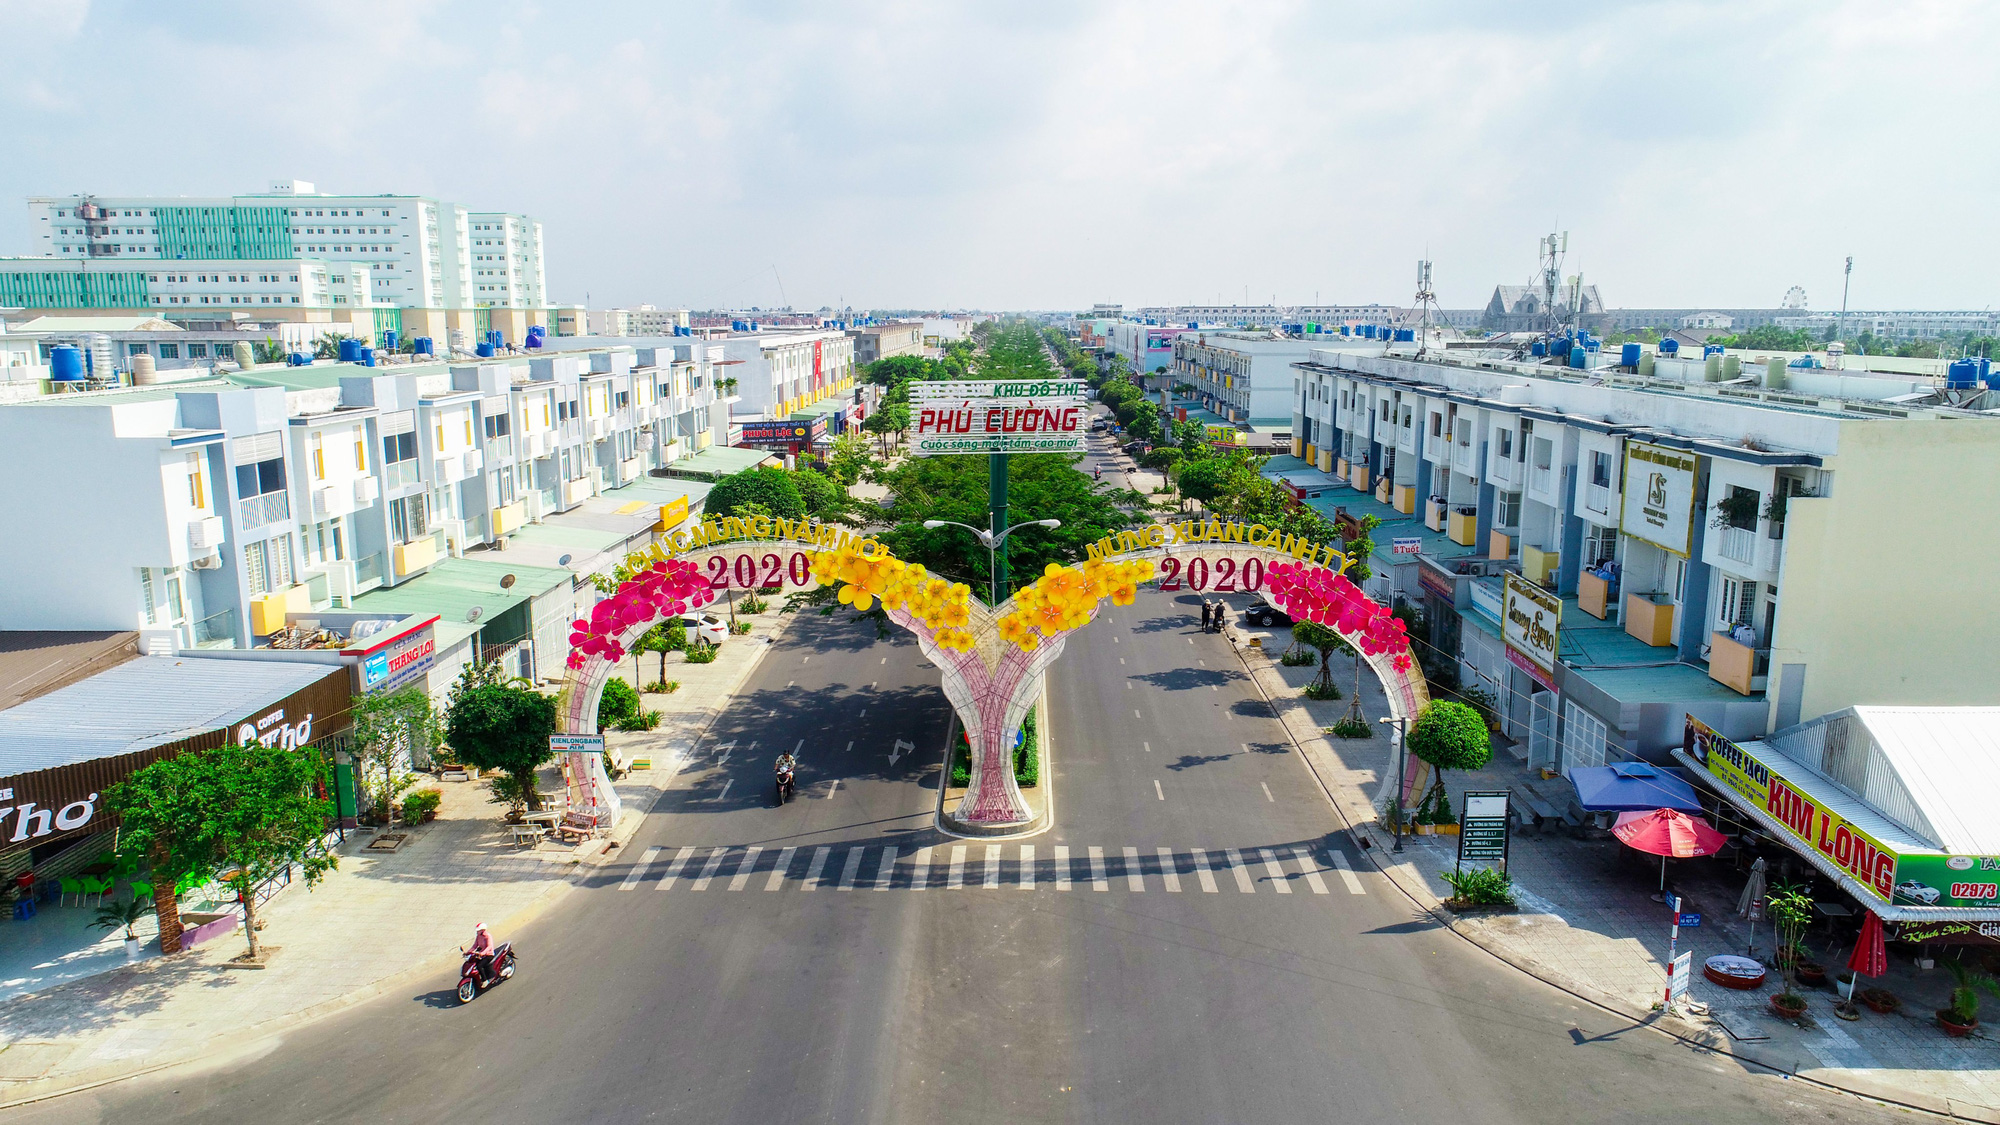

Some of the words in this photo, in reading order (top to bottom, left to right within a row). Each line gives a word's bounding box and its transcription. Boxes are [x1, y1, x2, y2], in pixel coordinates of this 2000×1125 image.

[993, 383, 1023, 397] KHU
[1029, 381, 1050, 397] ĐÔ
[1056, 382, 1079, 400] THỊ
[743, 428, 773, 438] PHƯỚC
[775, 427, 792, 439] LỘC
[918, 400, 973, 433] PHÚ
[985, 400, 1079, 433] CƯỜNG
[921, 439, 949, 450] Cuộc
[1034, 439, 1054, 448] cao
[691, 512, 771, 547] MỪNG
[775, 514, 837, 547] NĂM
[1085, 528, 1165, 560] MỪNG
[1170, 513, 1244, 544] XUÂN
[1248, 523, 1319, 564] CANH
[1321, 545, 1358, 576] TÝ
[708, 552, 811, 590] 2020
[1159, 557, 1265, 592] 2020
[257, 708, 284, 730] COFFEE
[1710, 733, 1743, 770] COFFEE
[1744, 754, 1769, 788] SẠCH
[1767, 775, 1815, 842] KIM
[1818, 810, 1895, 901] LONG
[1950, 882, 1998, 899] 02973
